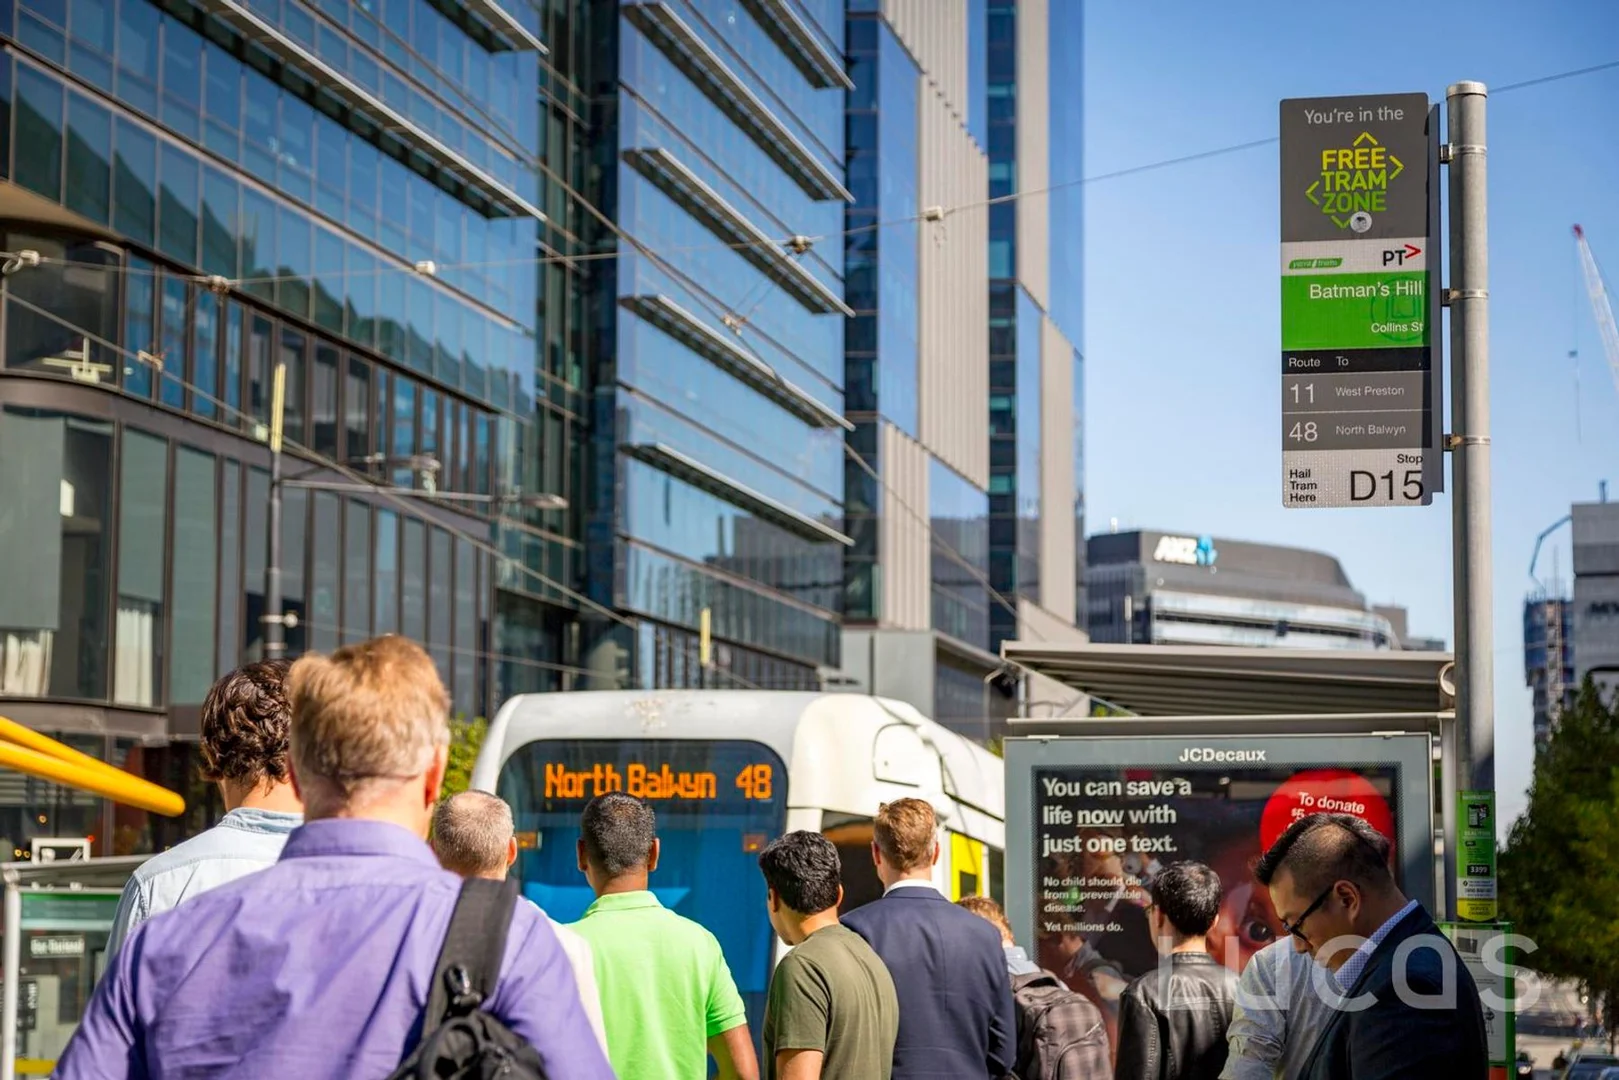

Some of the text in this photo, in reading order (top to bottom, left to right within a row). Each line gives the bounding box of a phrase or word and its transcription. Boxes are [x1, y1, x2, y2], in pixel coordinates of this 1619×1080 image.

[1304, 105, 1404, 125] You're in the
[1322, 147, 1387, 171] FREE
[1321, 169, 1387, 191] TRAM
[1322, 191, 1387, 213] ZONE
[1309, 280, 1422, 299] Batman's Hill
[1371, 321, 1424, 333] Collins St
[1288, 356, 1349, 368] Route To
[1290, 383, 1405, 404] 11 West Preston
[1289, 421, 1406, 442] 48 North Balwyn
[1396, 453, 1423, 466] Stop
[1289, 468, 1311, 479] Hail
[1290, 481, 1318, 491] Tram
[1350, 469, 1424, 501] D15
[1290, 493, 1316, 502] Here
[1179, 747, 1266, 762] JCDecaux
[545, 763, 772, 799] North Balwyn 48
[1042, 777, 1192, 797] You can save a
[1299, 791, 1365, 814] To donate
[1043, 804, 1176, 826] life now with
[1042, 833, 1177, 857] just one text.
[1043, 876, 1142, 887] No child should die
[1044, 889, 1069, 900] from
[1080, 889, 1142, 901] preventable
[1044, 902, 1086, 913] disease.
[1044, 921, 1124, 932] Yet millions do.
